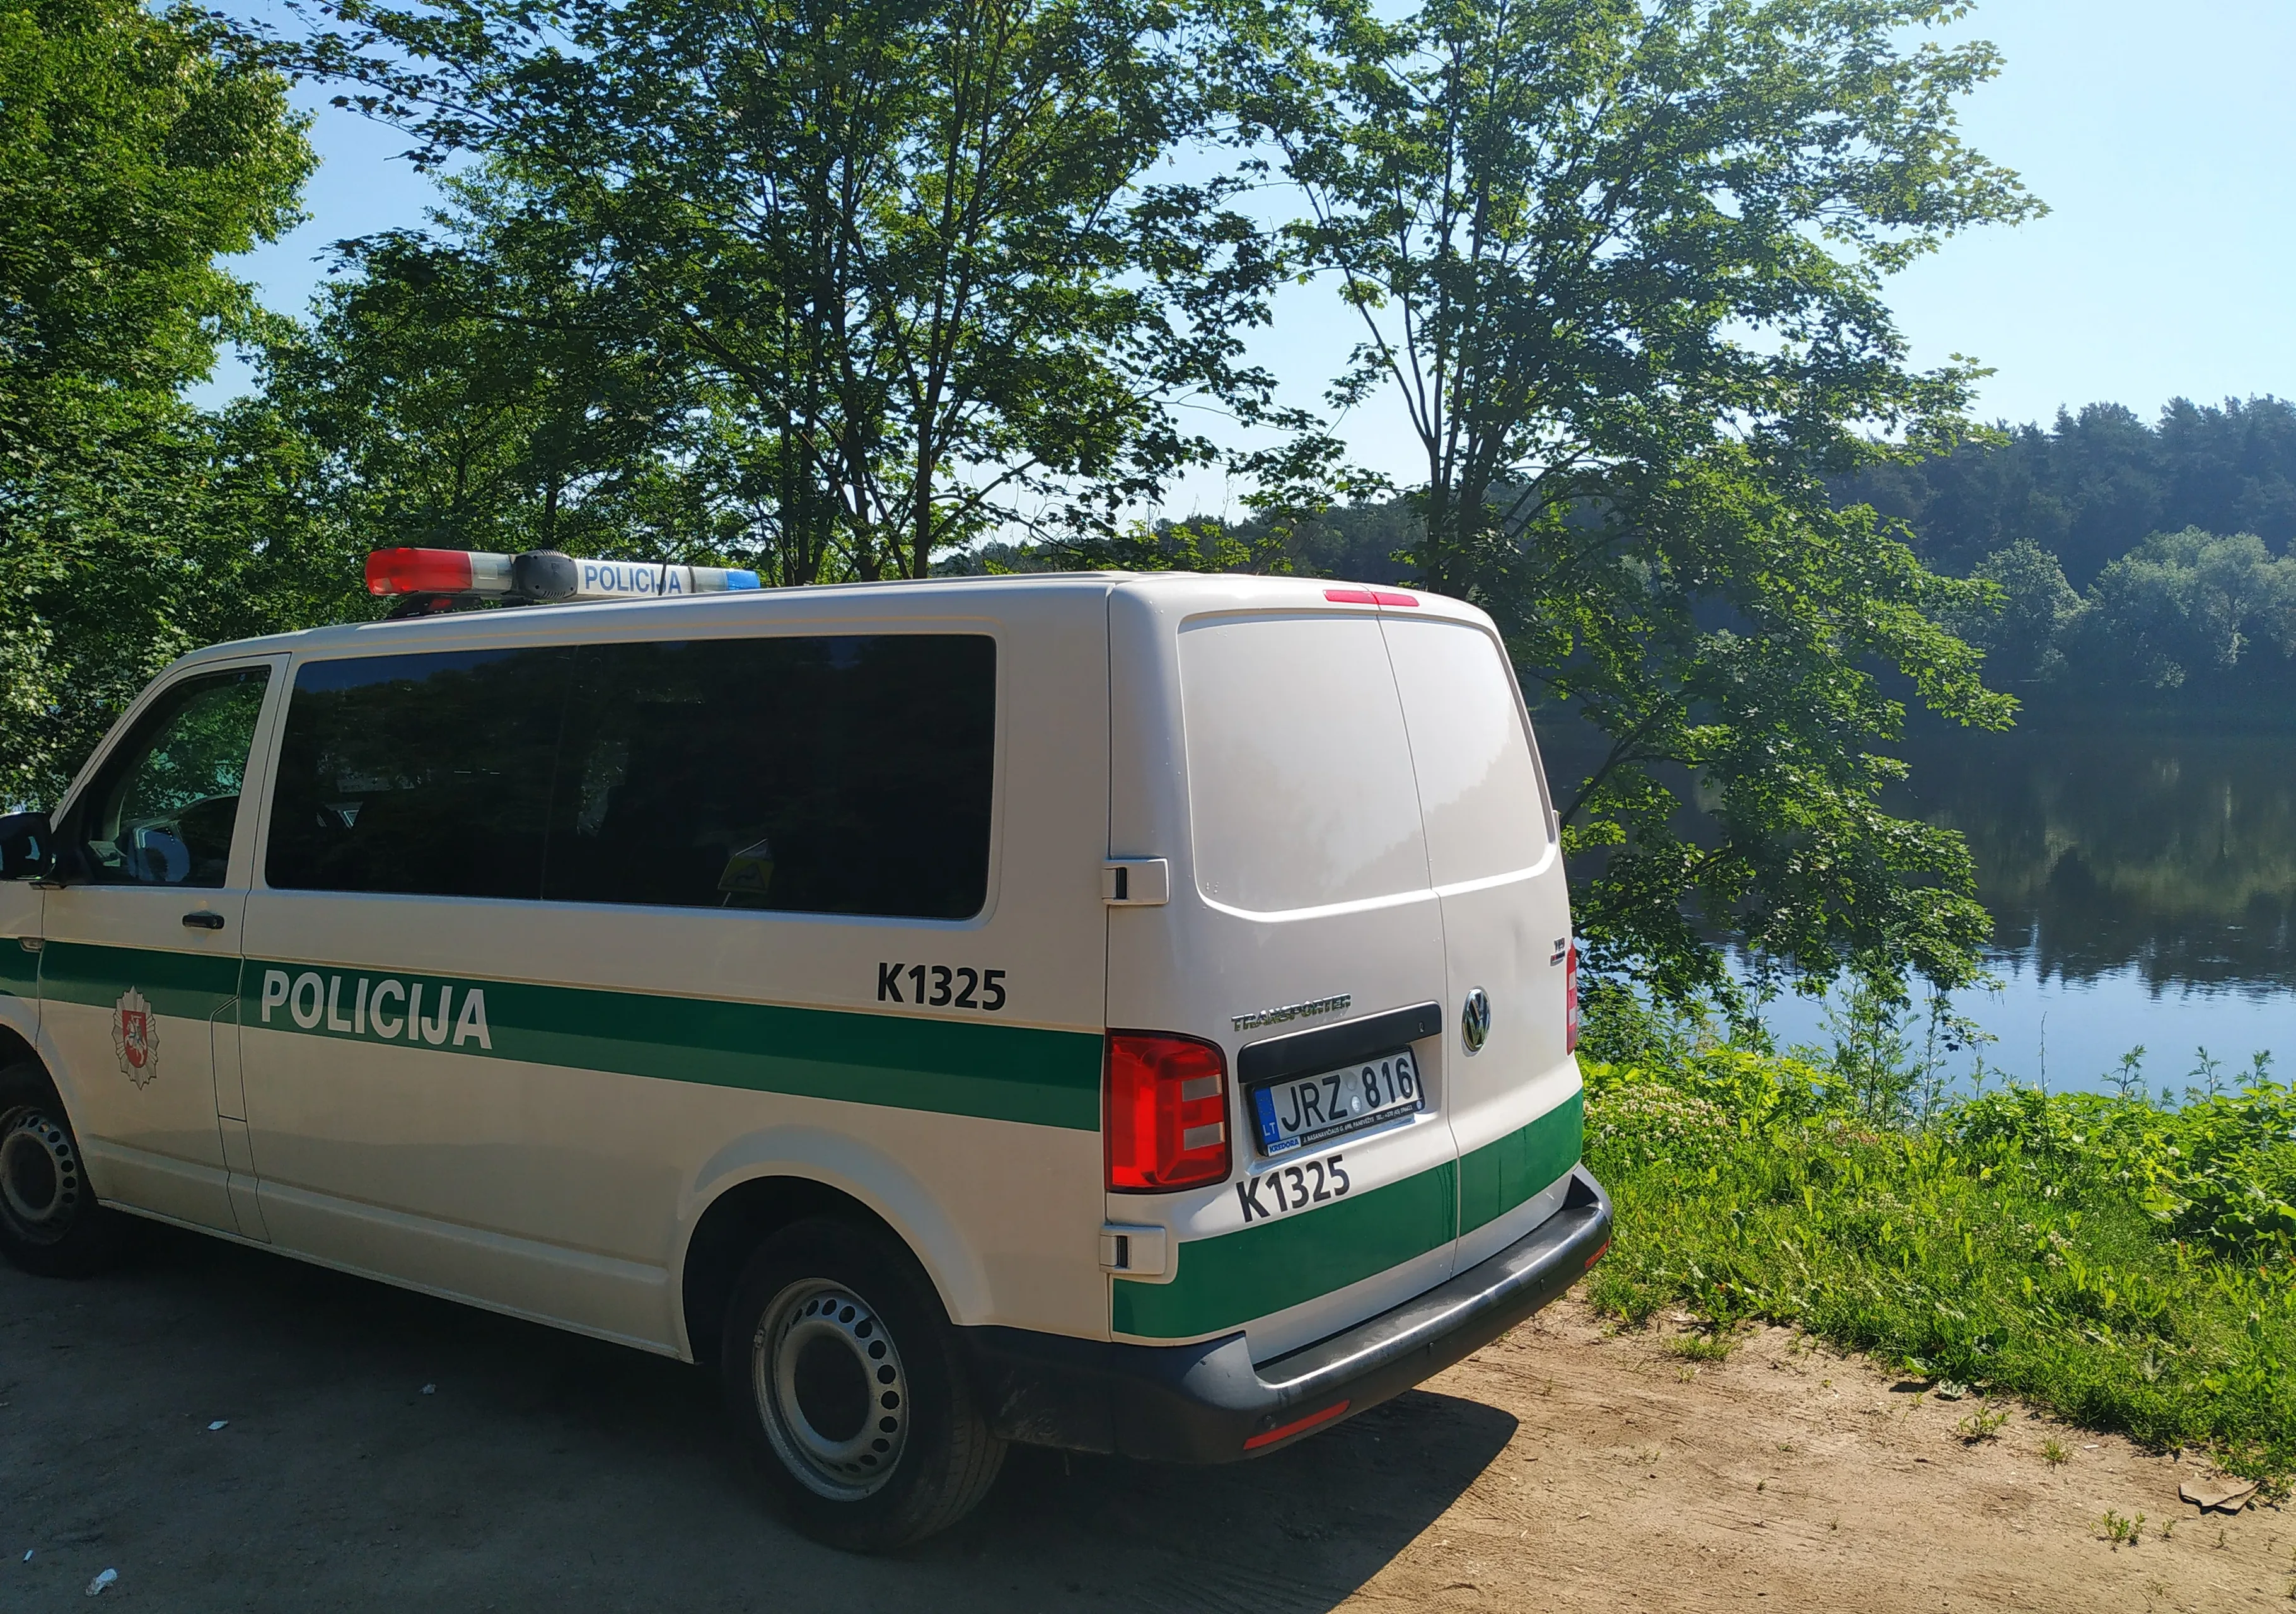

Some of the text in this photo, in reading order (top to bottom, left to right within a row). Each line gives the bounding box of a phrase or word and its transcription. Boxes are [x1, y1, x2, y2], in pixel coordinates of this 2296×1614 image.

[260, 969, 492, 1050] POLICIJA
[878, 962, 1006, 1011] K1325
[1231, 993, 1351, 1031] TRANSPORTER
[1281, 1057, 1413, 1132] JRZ 816
[1263, 1122, 1275, 1136] LT
[1269, 1138, 1299, 1153] KREDORA
[1236, 1154, 1350, 1223] K1325
